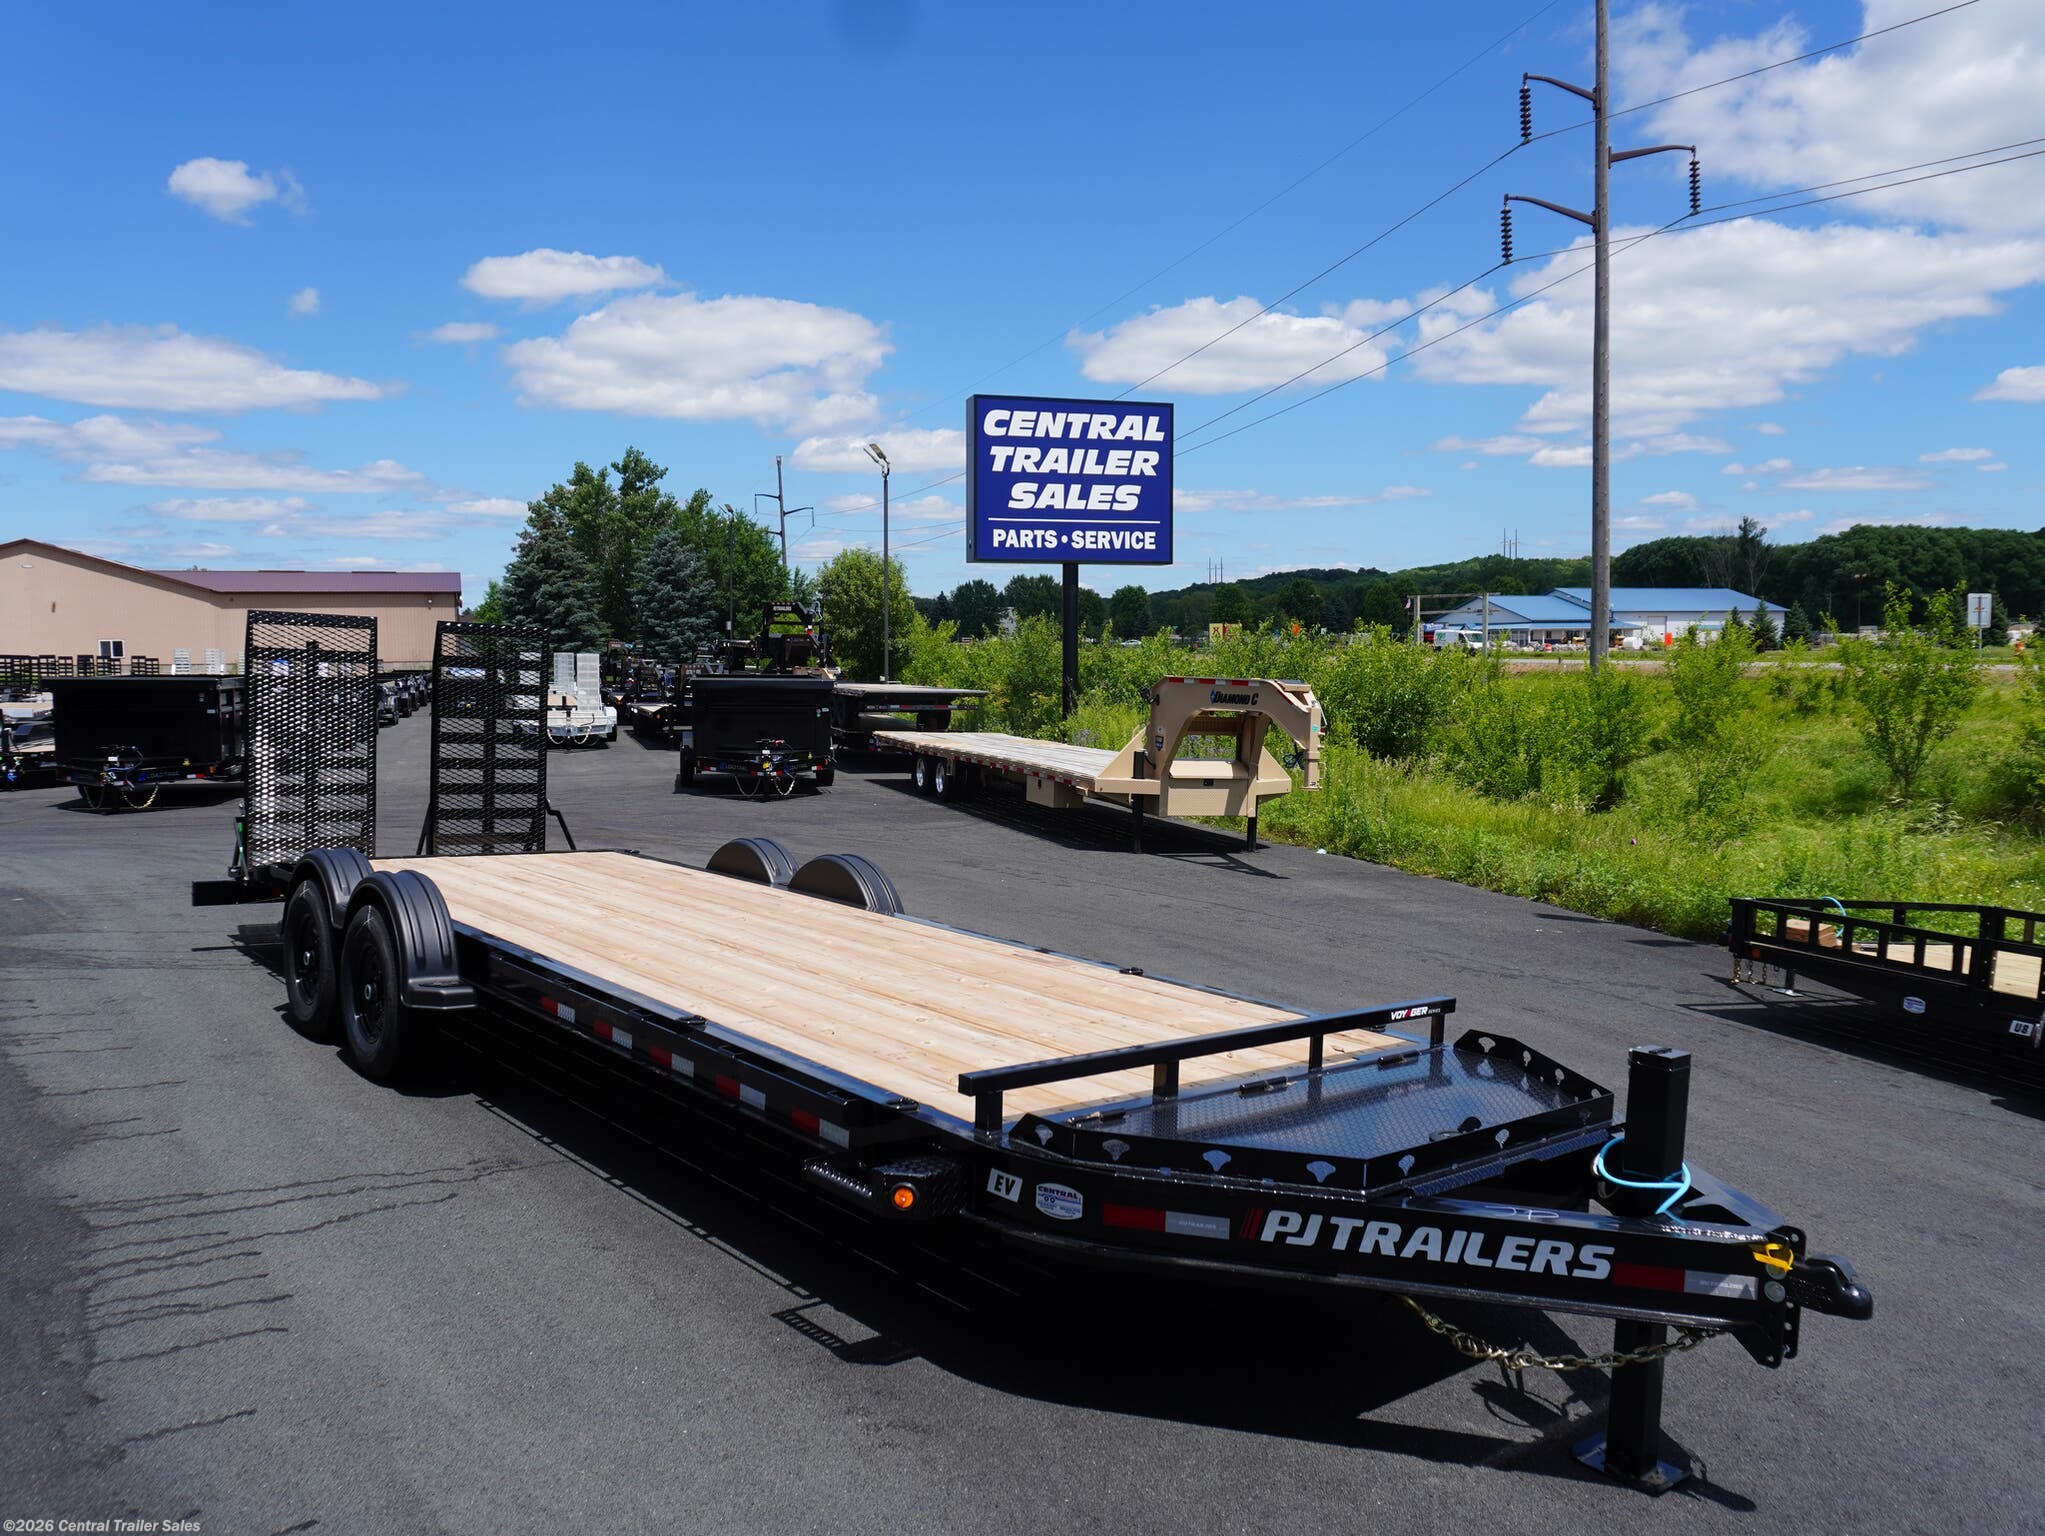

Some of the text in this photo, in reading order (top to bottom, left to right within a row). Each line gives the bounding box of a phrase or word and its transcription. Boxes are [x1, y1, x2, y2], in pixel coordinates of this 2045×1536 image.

[983, 409, 1165, 442] CENTRAL
[989, 446, 1160, 476] TRAILER
[1008, 482, 1142, 511] SALES
[992, 529, 1156, 550] PARTS SERVICE
[1215, 691, 1259, 706] DIAMOND C
[1391, 1006, 1429, 1020] VOYAGER
[994, 1174, 1016, 1196] EV
[1038, 1186, 1079, 1200] CENTRAL
[1260, 1209, 1615, 1280] PJ TRAILERS
